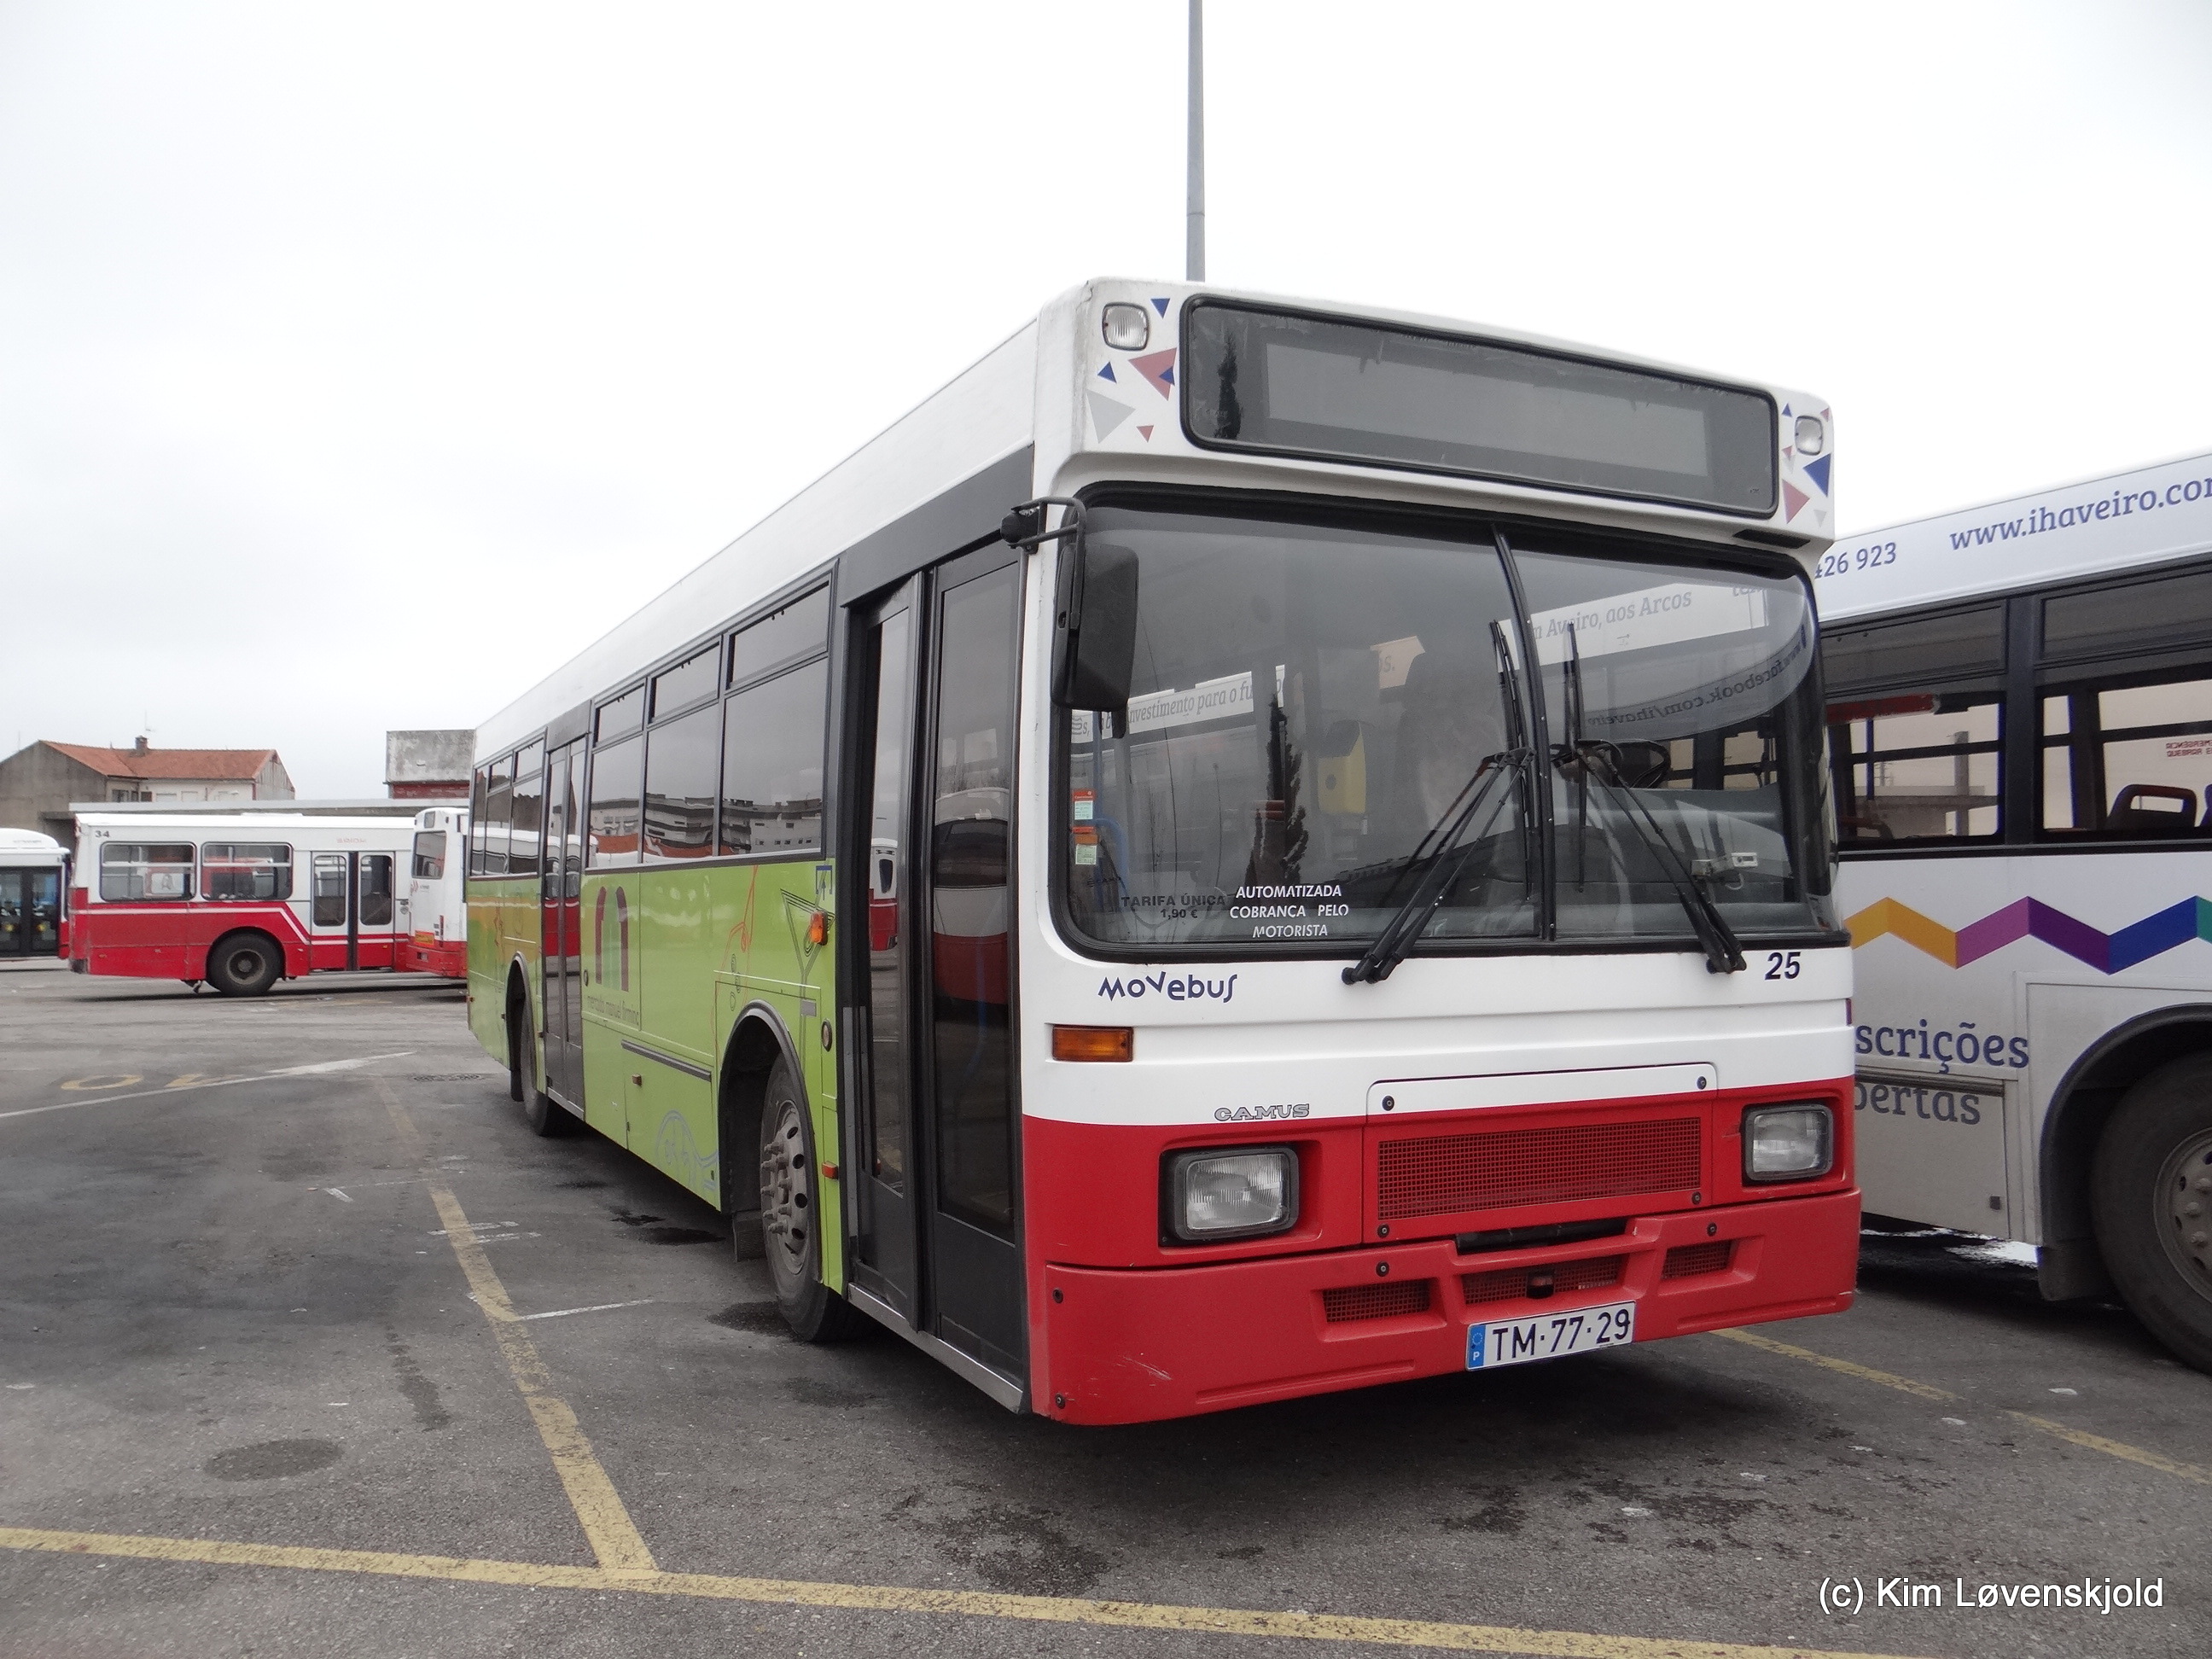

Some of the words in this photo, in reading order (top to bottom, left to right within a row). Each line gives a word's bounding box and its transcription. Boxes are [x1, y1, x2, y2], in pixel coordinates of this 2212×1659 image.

[1950, 477, 2212, 550] www.ihaveiro.co
[1856, 542, 1897, 571] 923
[1605, 604, 1636, 625] aos
[1639, 591, 1693, 618] Arcos
[1196, 691, 1227, 715] para
[1229, 691, 1238, 703] o
[95, 830, 110, 838] 34
[1121, 895, 1176, 907] TARIFA
[1180, 893, 1225, 906] ÚNICA
[1236, 884, 1342, 899] AUTOMATIZADA
[1160, 908, 1187, 920] 1,90
[1190, 909, 1198, 919] €
[1318, 904, 1349, 917] PELO
[1252, 924, 1328, 938] MOTORISTA
[1764, 951, 1802, 981] 25
[1855, 1018, 2030, 1074] scrições
[1214, 1103, 1311, 1122] CAMUS
[1472, 1351, 1481, 1361] P
